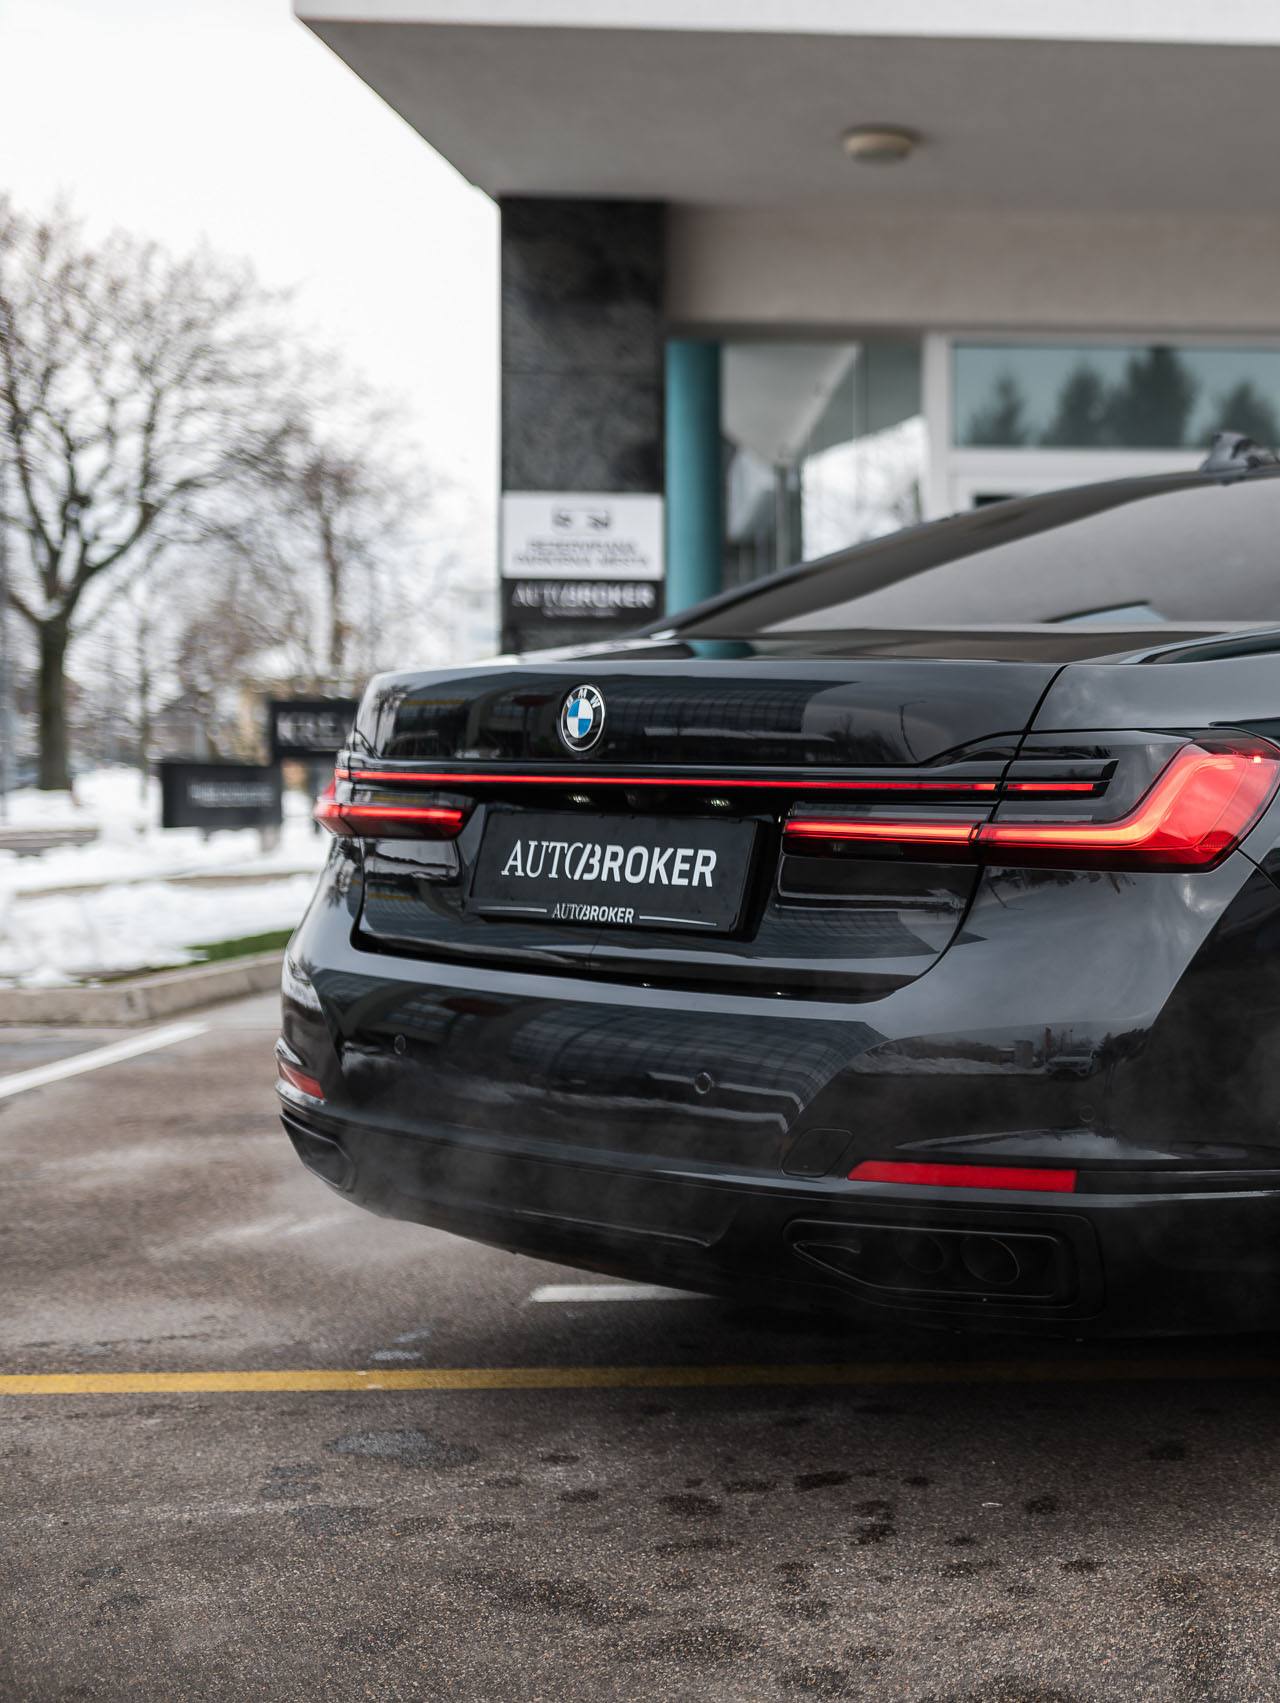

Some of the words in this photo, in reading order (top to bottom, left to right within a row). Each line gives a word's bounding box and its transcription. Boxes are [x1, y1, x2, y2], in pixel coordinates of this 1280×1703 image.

[566, 688, 601, 709] BMW
[501, 839, 717, 887] AUTOBROKER
[552, 903, 634, 923] AUTOBROKER
